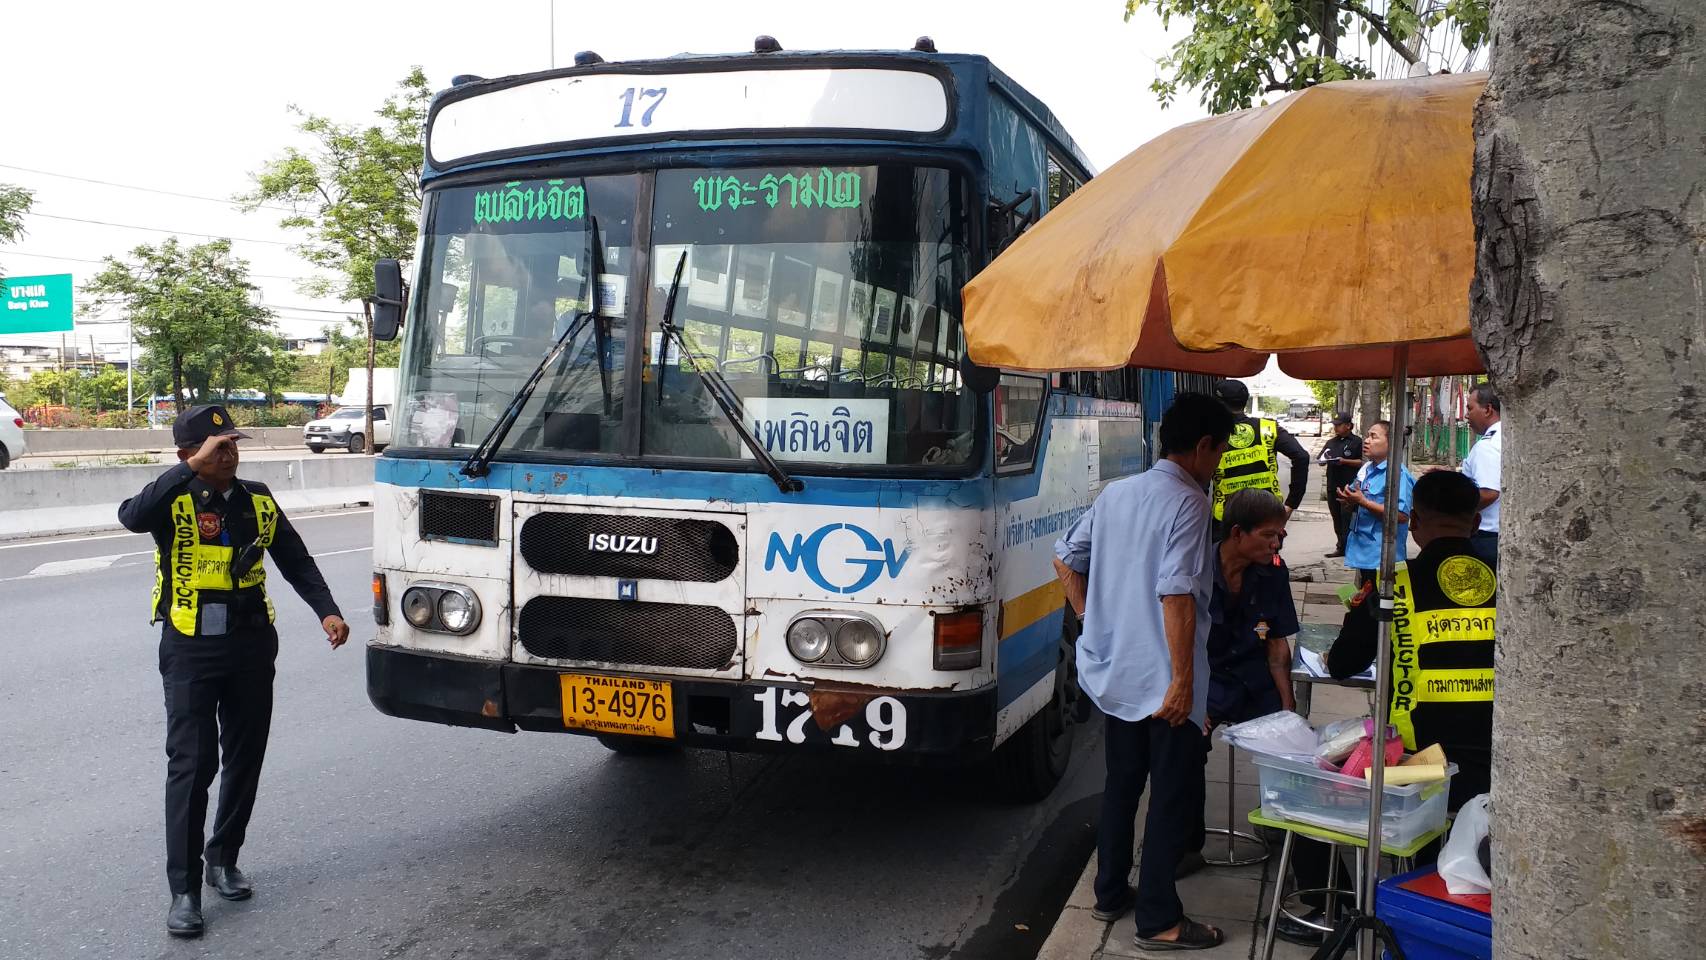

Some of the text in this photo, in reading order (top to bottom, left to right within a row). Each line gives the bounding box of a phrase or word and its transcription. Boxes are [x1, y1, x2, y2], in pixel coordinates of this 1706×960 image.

[614, 87, 667, 127] 17
[474, 179, 585, 224] เพลินจิต
[754, 405, 874, 454] เพลินจิต
[175, 501, 194, 610] INSPECTOR
[588, 533, 659, 555] ISUZU
[764, 522, 913, 594] NGV
[571, 686, 666, 722] 13-4976
[585, 677, 645, 690] THAILAND
[753, 687, 907, 750] 179
